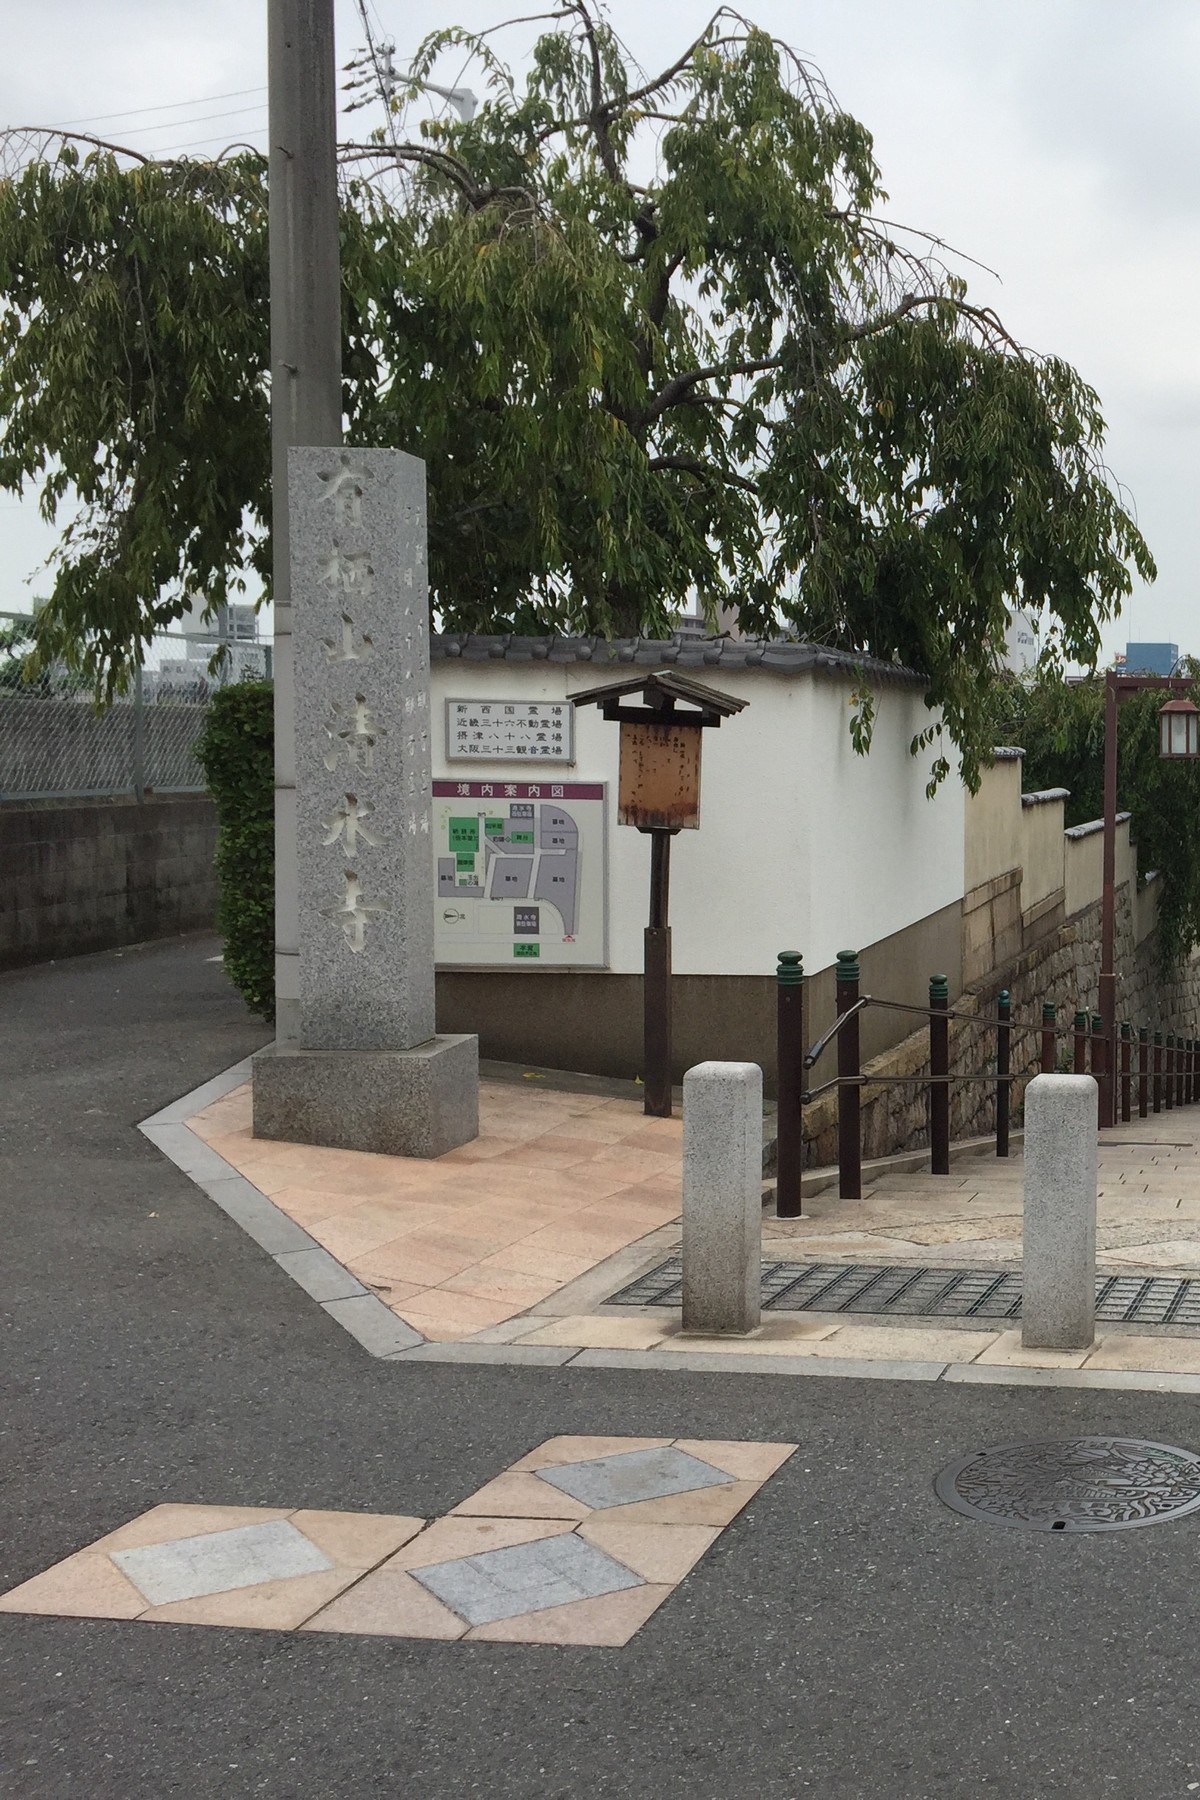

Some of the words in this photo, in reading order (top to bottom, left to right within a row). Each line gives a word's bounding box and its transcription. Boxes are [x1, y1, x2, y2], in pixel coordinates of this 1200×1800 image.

[315, 454, 391, 954] 有栖山清水寺
[456, 704, 563, 715] 新西国霊場
[456, 718, 563, 729] 近畿三十六不動霊場
[456, 731, 563, 742] 摂津八十八霊場
[457, 744, 563, 755] 大阪三十三観音霊場
[457, 783, 564, 798] 境内案内図
